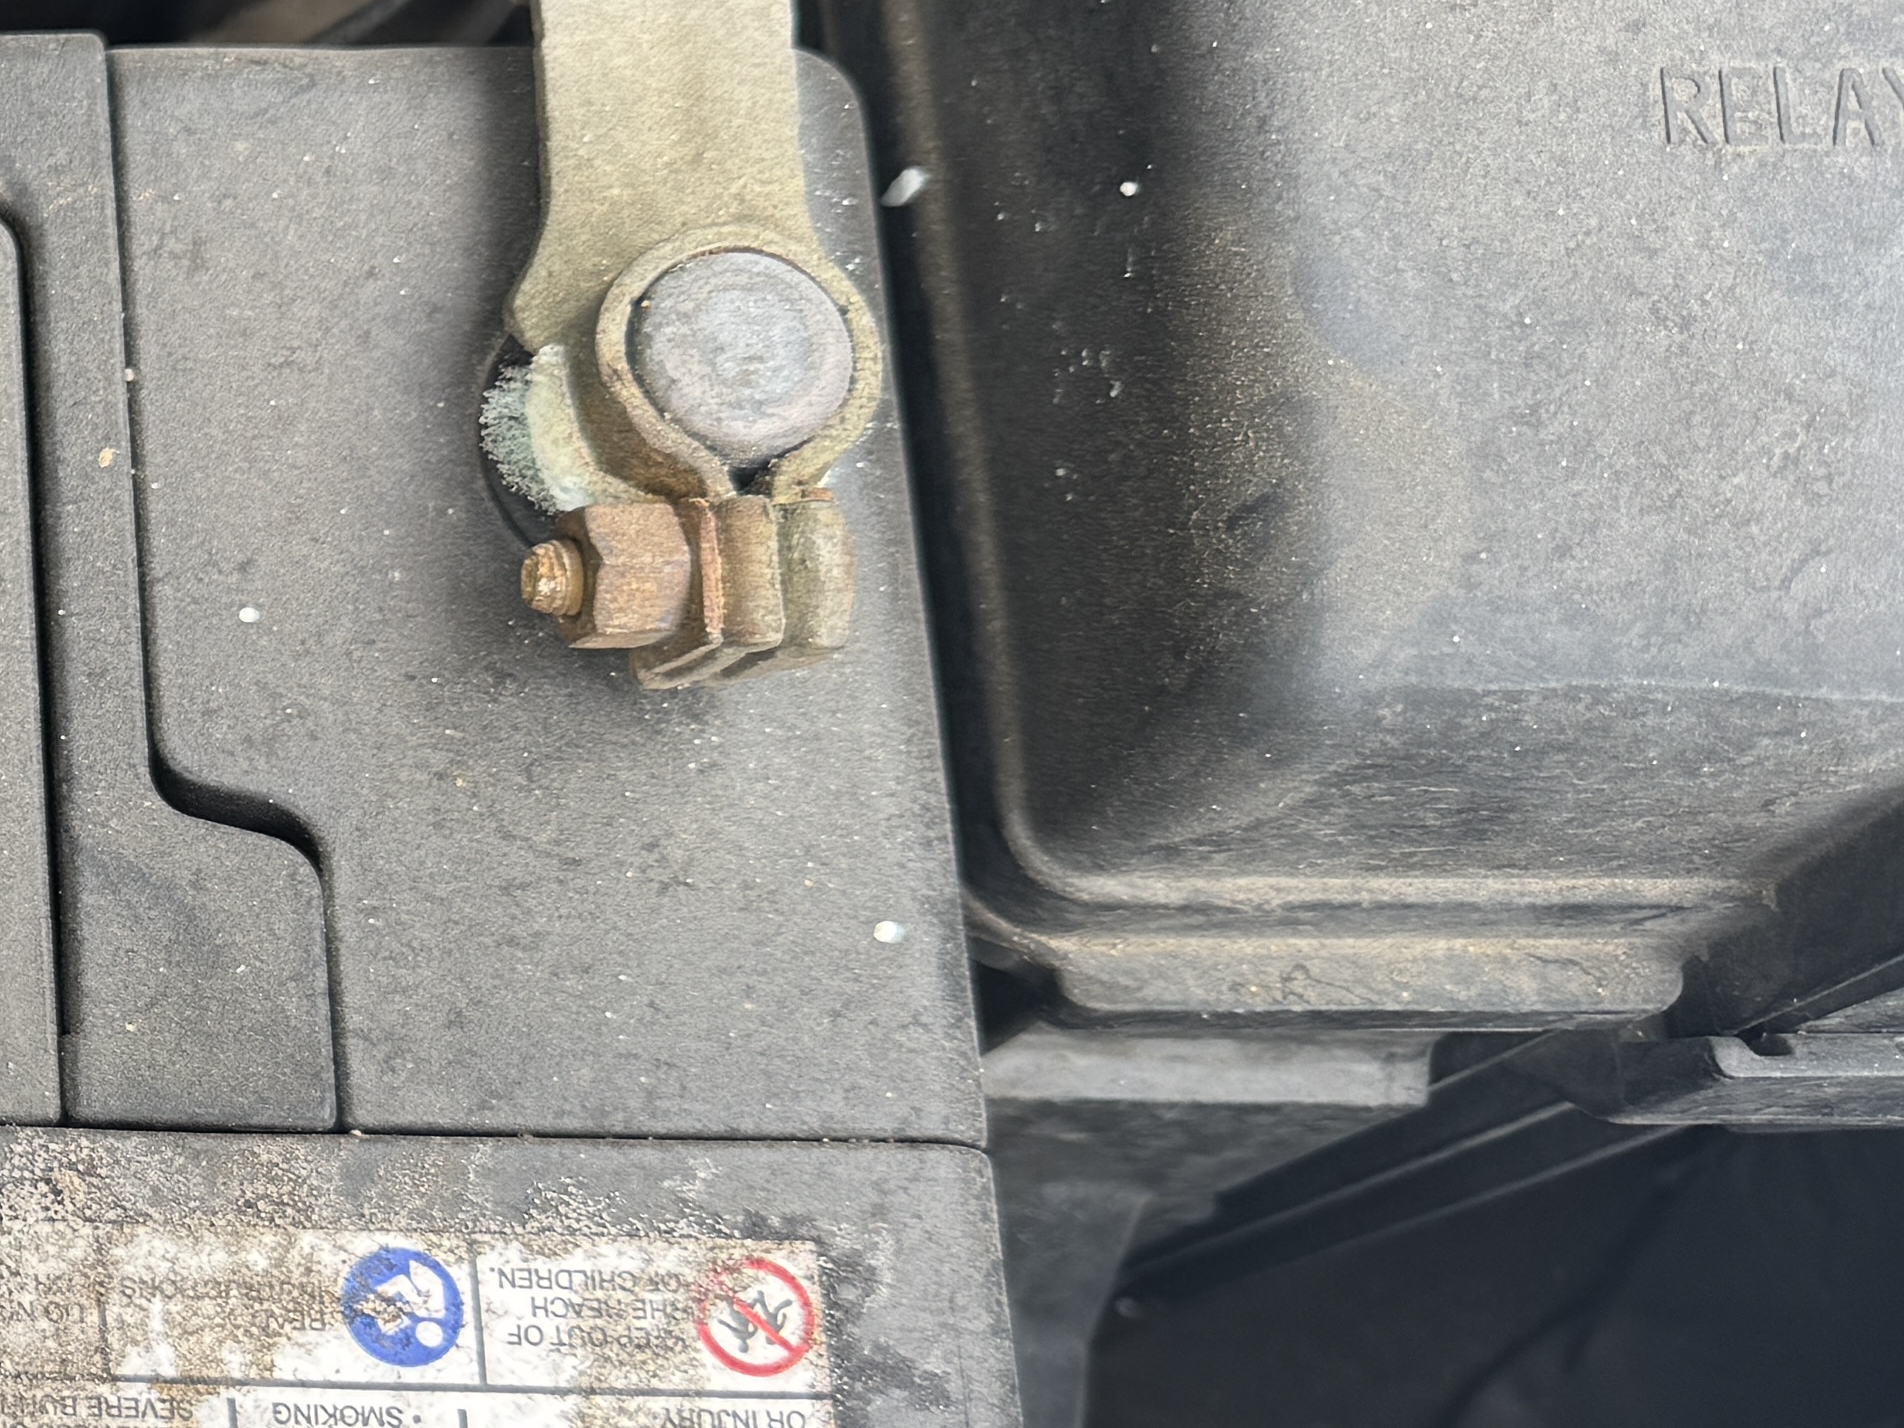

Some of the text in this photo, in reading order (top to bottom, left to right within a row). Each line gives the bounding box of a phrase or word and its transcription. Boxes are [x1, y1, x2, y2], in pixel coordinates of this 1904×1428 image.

[489, 1266, 636, 1293] CHILDREN.
[506, 1323, 544, 1346] OF
[87, 1396, 193, 1422] SEVERE
